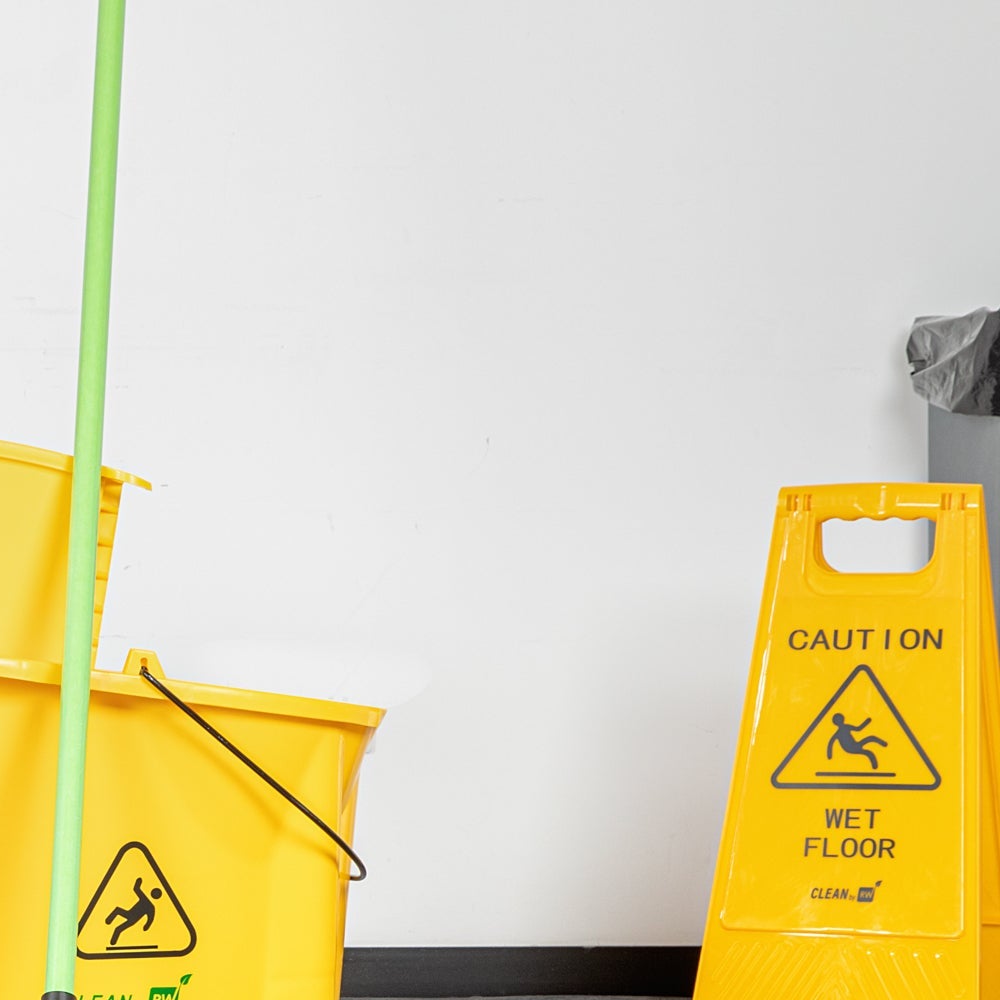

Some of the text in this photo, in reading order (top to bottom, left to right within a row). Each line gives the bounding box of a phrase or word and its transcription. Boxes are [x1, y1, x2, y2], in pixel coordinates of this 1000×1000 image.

[788, 628, 944, 651] CAUTION
[825, 808, 881, 829] WET
[803, 837, 896, 859] FLOOR
[810, 887, 850, 900] CLEAN
[858, 889, 874, 900] RW
